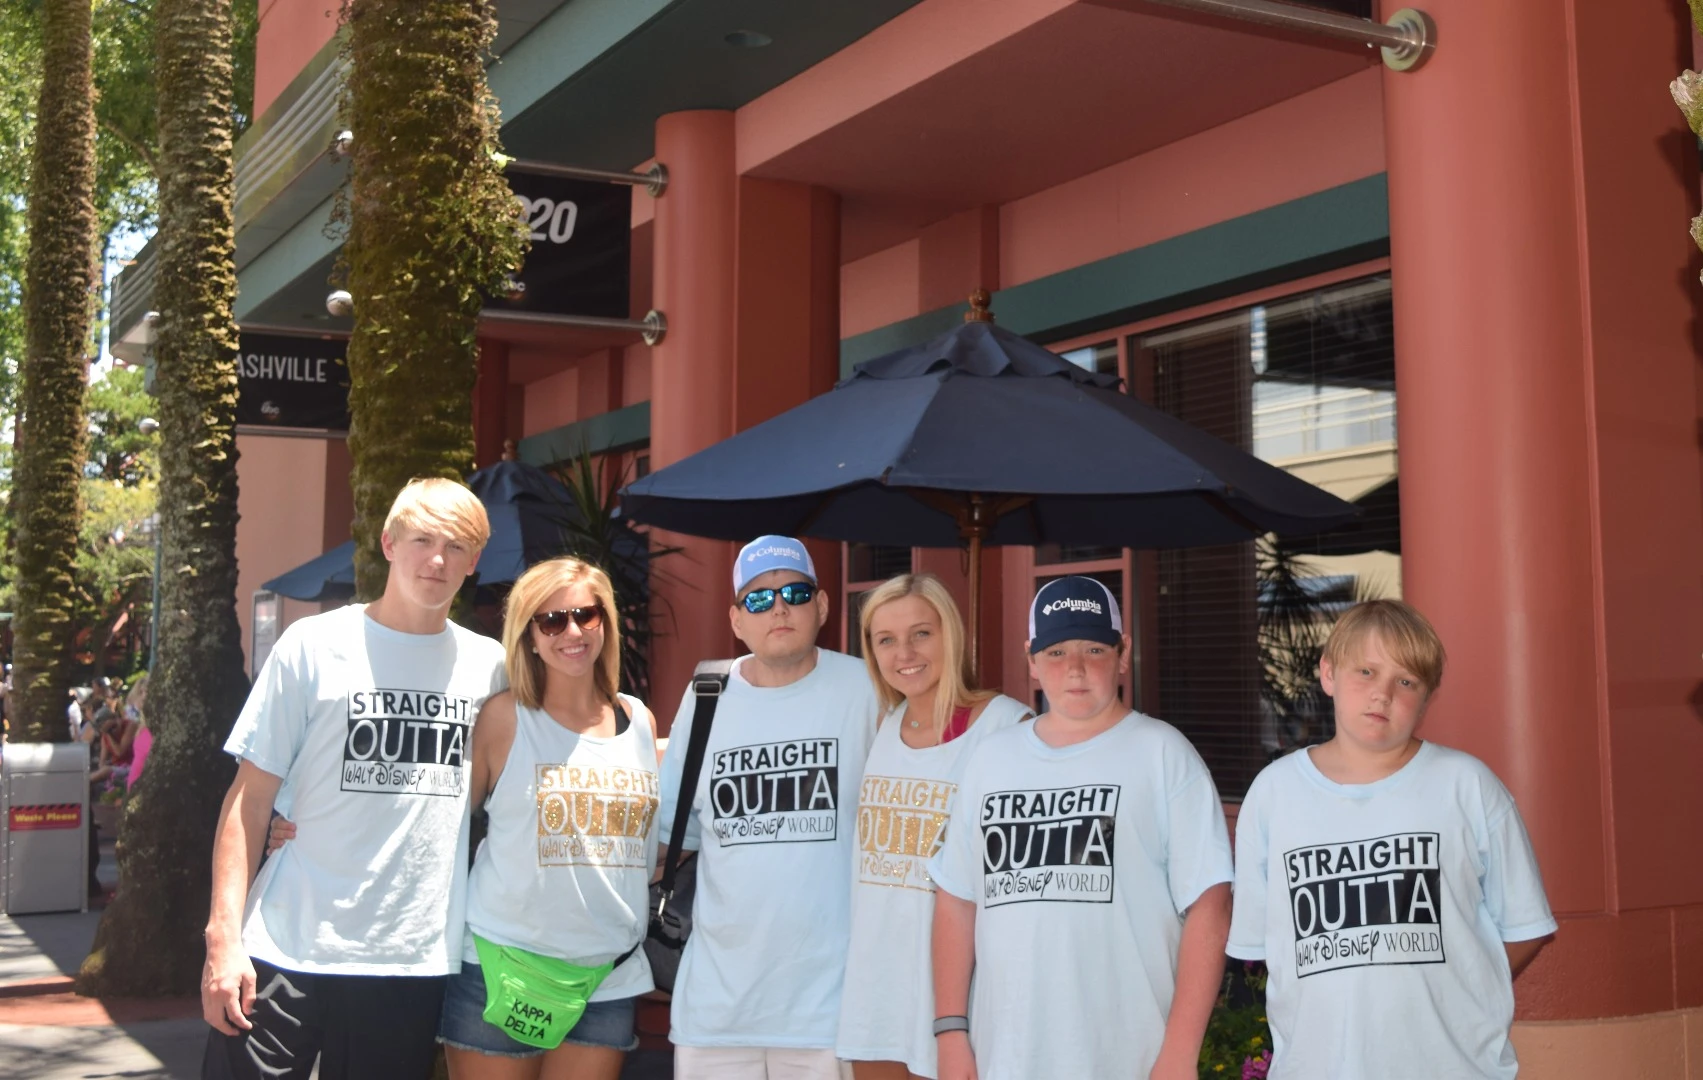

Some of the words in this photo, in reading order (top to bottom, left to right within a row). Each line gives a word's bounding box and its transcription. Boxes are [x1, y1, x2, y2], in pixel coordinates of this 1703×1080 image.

[236, 353, 327, 382] ASHVILLE
[756, 546, 800, 559] Columbia
[1052, 597, 1101, 611] Columbia
[353, 692, 468, 720] STRAIGHT
[349, 719, 463, 766] OUTTA
[715, 741, 832, 775] STRAIGHT
[541, 766, 653, 793] STRAIGHT
[713, 769, 835, 818] OUTTA
[861, 778, 957, 809] STRAIGH
[15, 814, 44, 822] Waste
[46, 812, 77, 820] Please
[983, 788, 1113, 821] STRAIGHT
[787, 816, 834, 834] WORLD
[984, 819, 1111, 872] OUTTA
[1288, 836, 1433, 883] STRAIGHT
[1056, 873, 1110, 892] WORLD
[1294, 872, 1438, 938] OUTTA
[1383, 932, 1440, 953] WORLD
[511, 998, 553, 1026] KAPPA
[504, 1015, 545, 1039] DELTA
